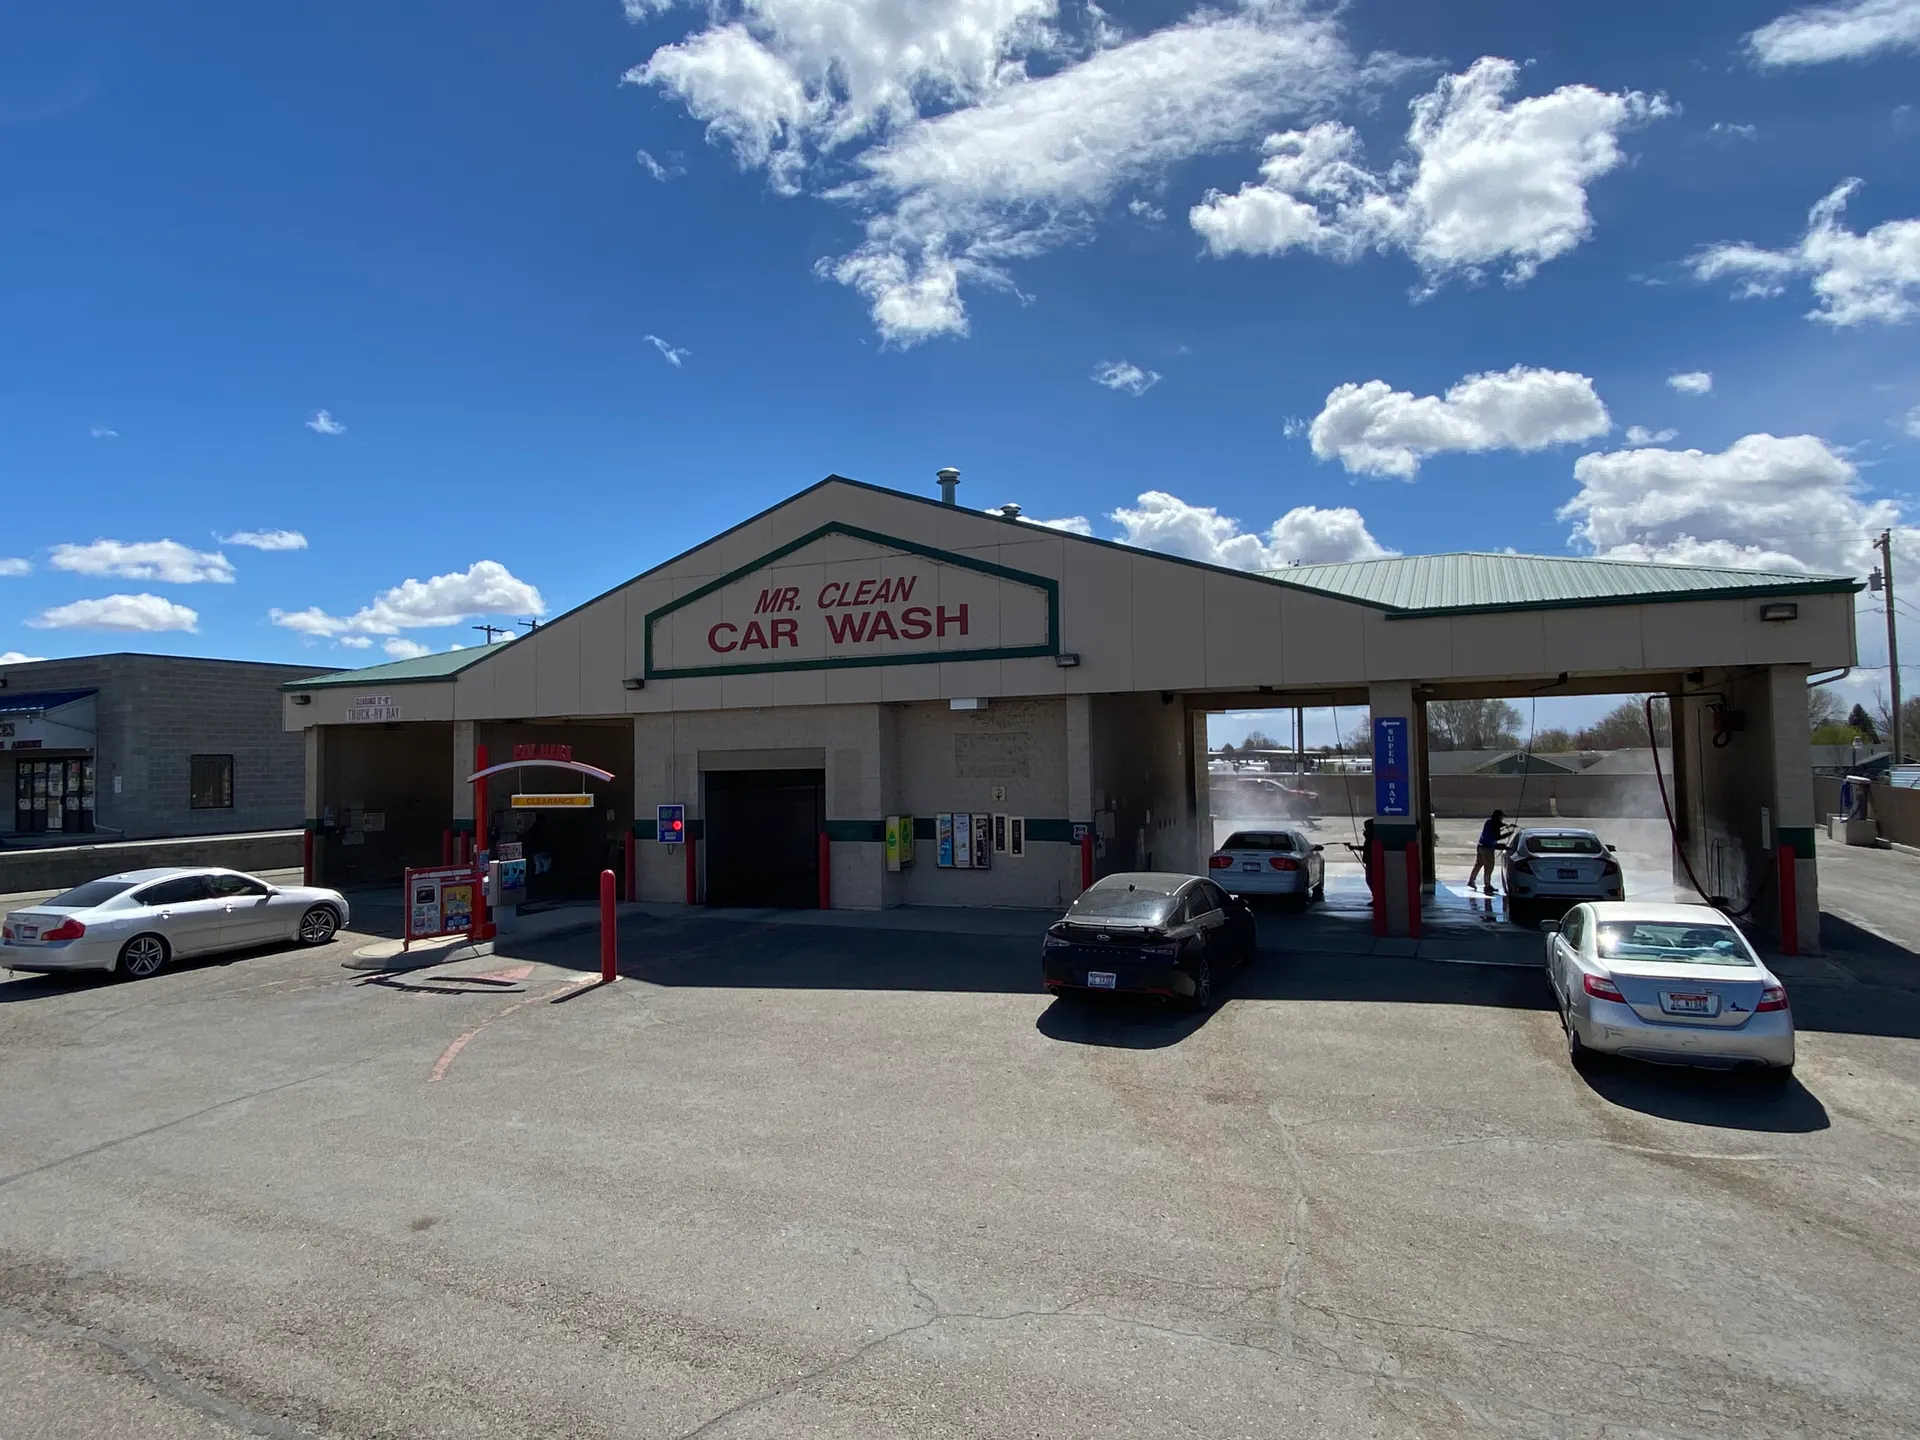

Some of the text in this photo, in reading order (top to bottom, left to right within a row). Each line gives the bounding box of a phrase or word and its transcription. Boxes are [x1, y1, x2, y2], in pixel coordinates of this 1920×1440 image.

[754, 576, 917, 614] MR. CLEAN
[708, 603, 969, 652] CAR WASH
[386, 707, 400, 719] BAY
[1387, 728, 1395, 764] SUPER
[526, 797, 576, 805] CLEARANCE
[1388, 782, 1396, 804] BAY
